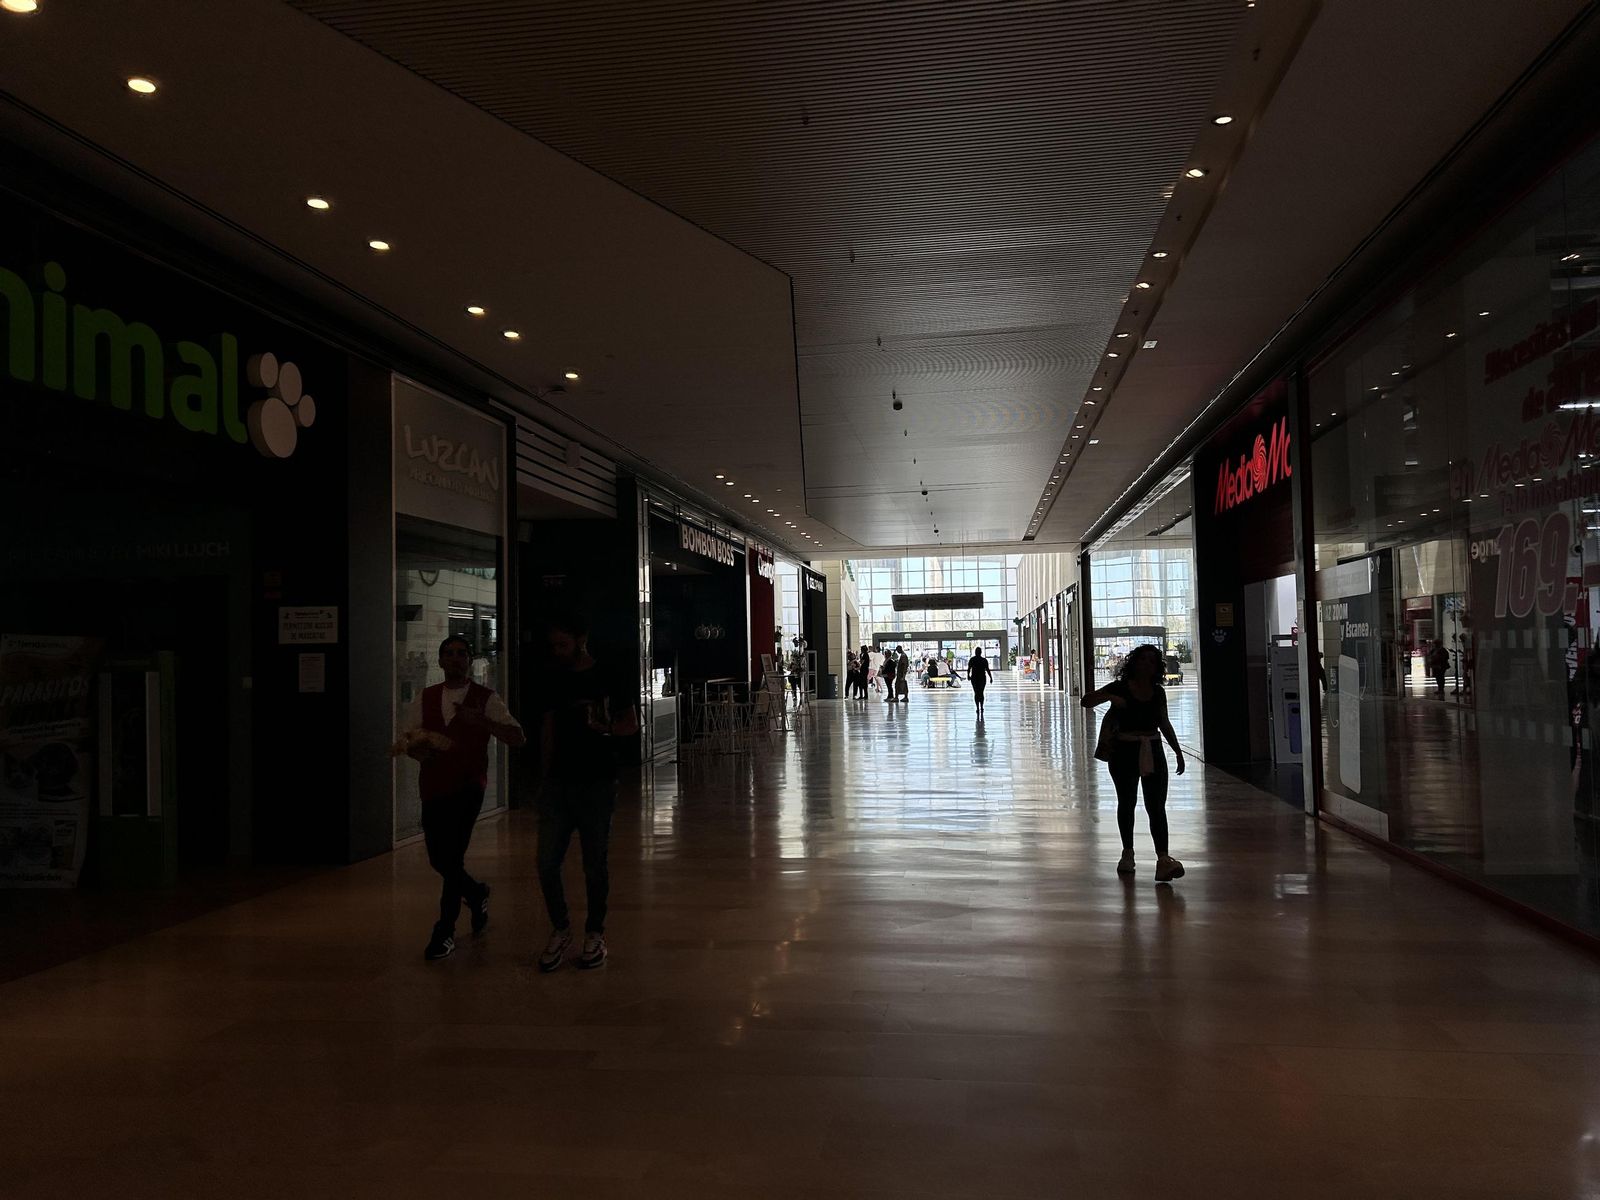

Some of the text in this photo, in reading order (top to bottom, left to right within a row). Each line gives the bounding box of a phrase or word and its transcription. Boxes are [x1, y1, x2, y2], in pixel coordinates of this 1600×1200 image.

[681, 523, 735, 567] BOMBON BOSS
[1346, 621, 1369, 638] Escanea
